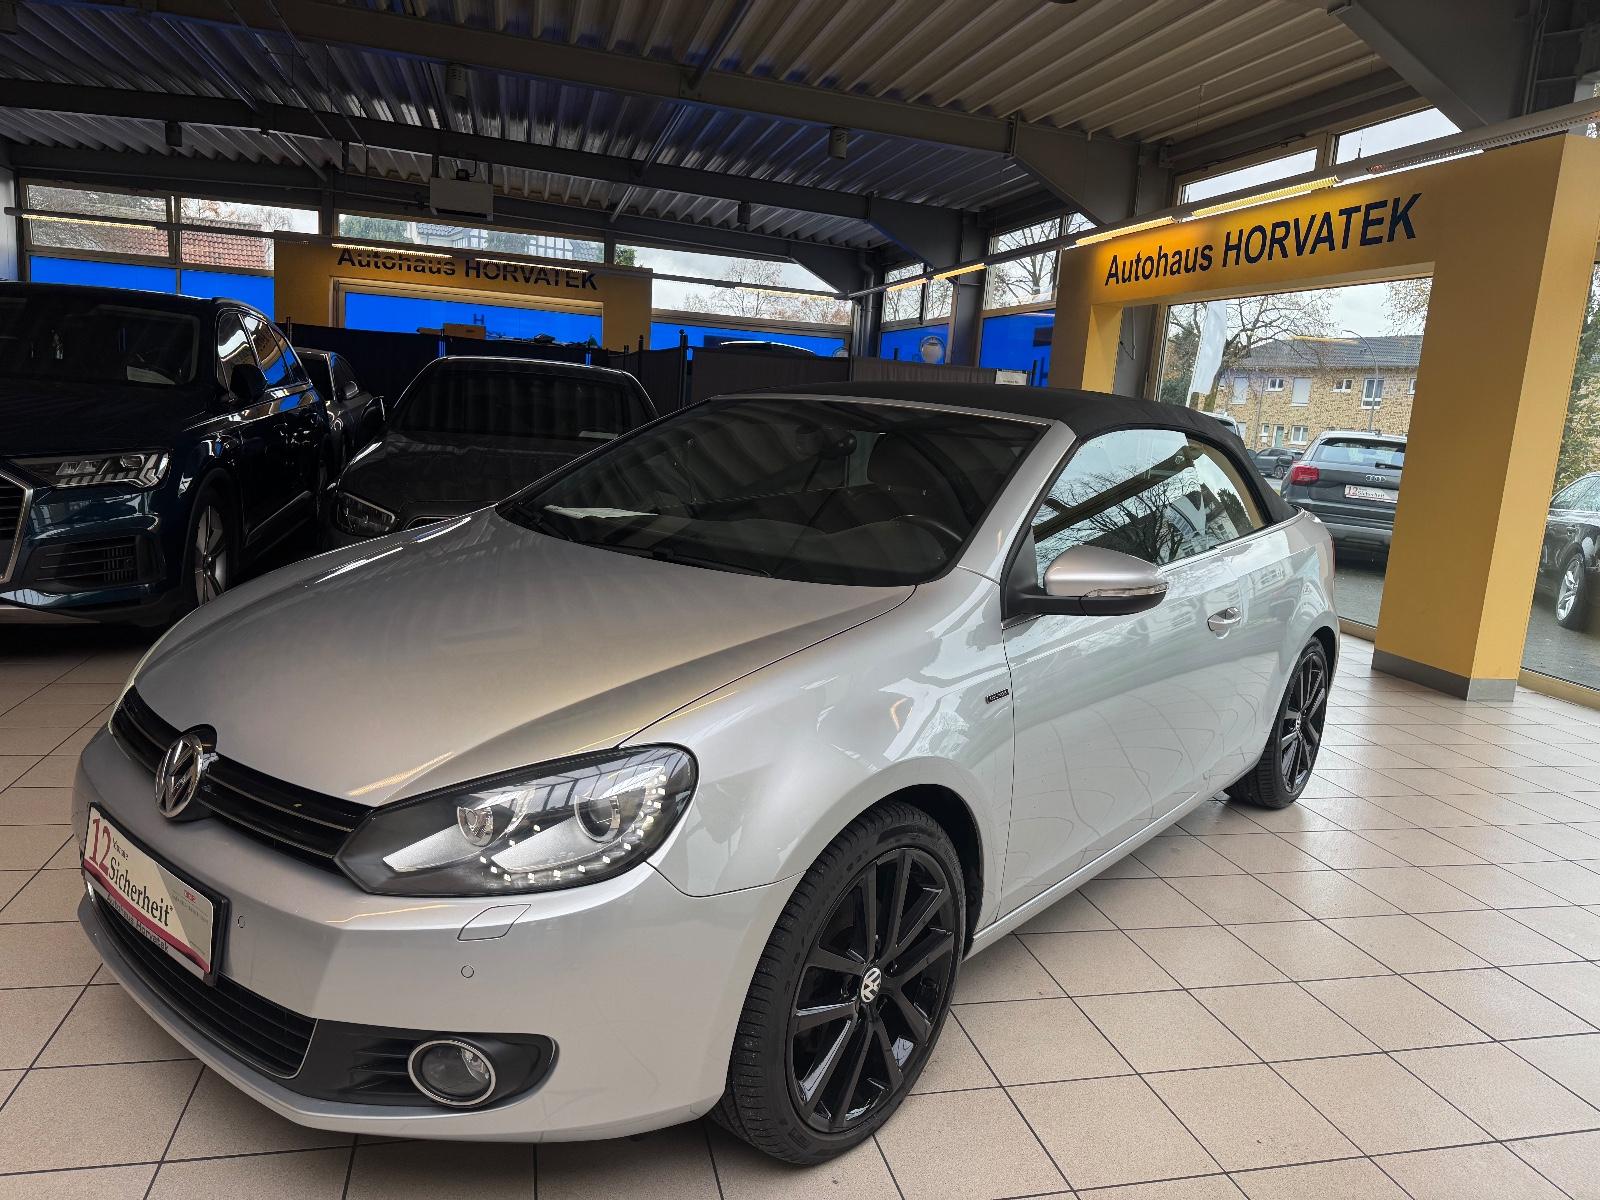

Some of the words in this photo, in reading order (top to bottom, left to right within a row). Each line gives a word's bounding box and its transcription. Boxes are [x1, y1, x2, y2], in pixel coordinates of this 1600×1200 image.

[1104, 243, 1214, 287] Autohaus
[1221, 192, 1423, 268] HORVATEK
[337, 249, 456, 276] Autohaus
[464, 259, 598, 291] HORVATEK
[89, 818, 112, 874] 12
